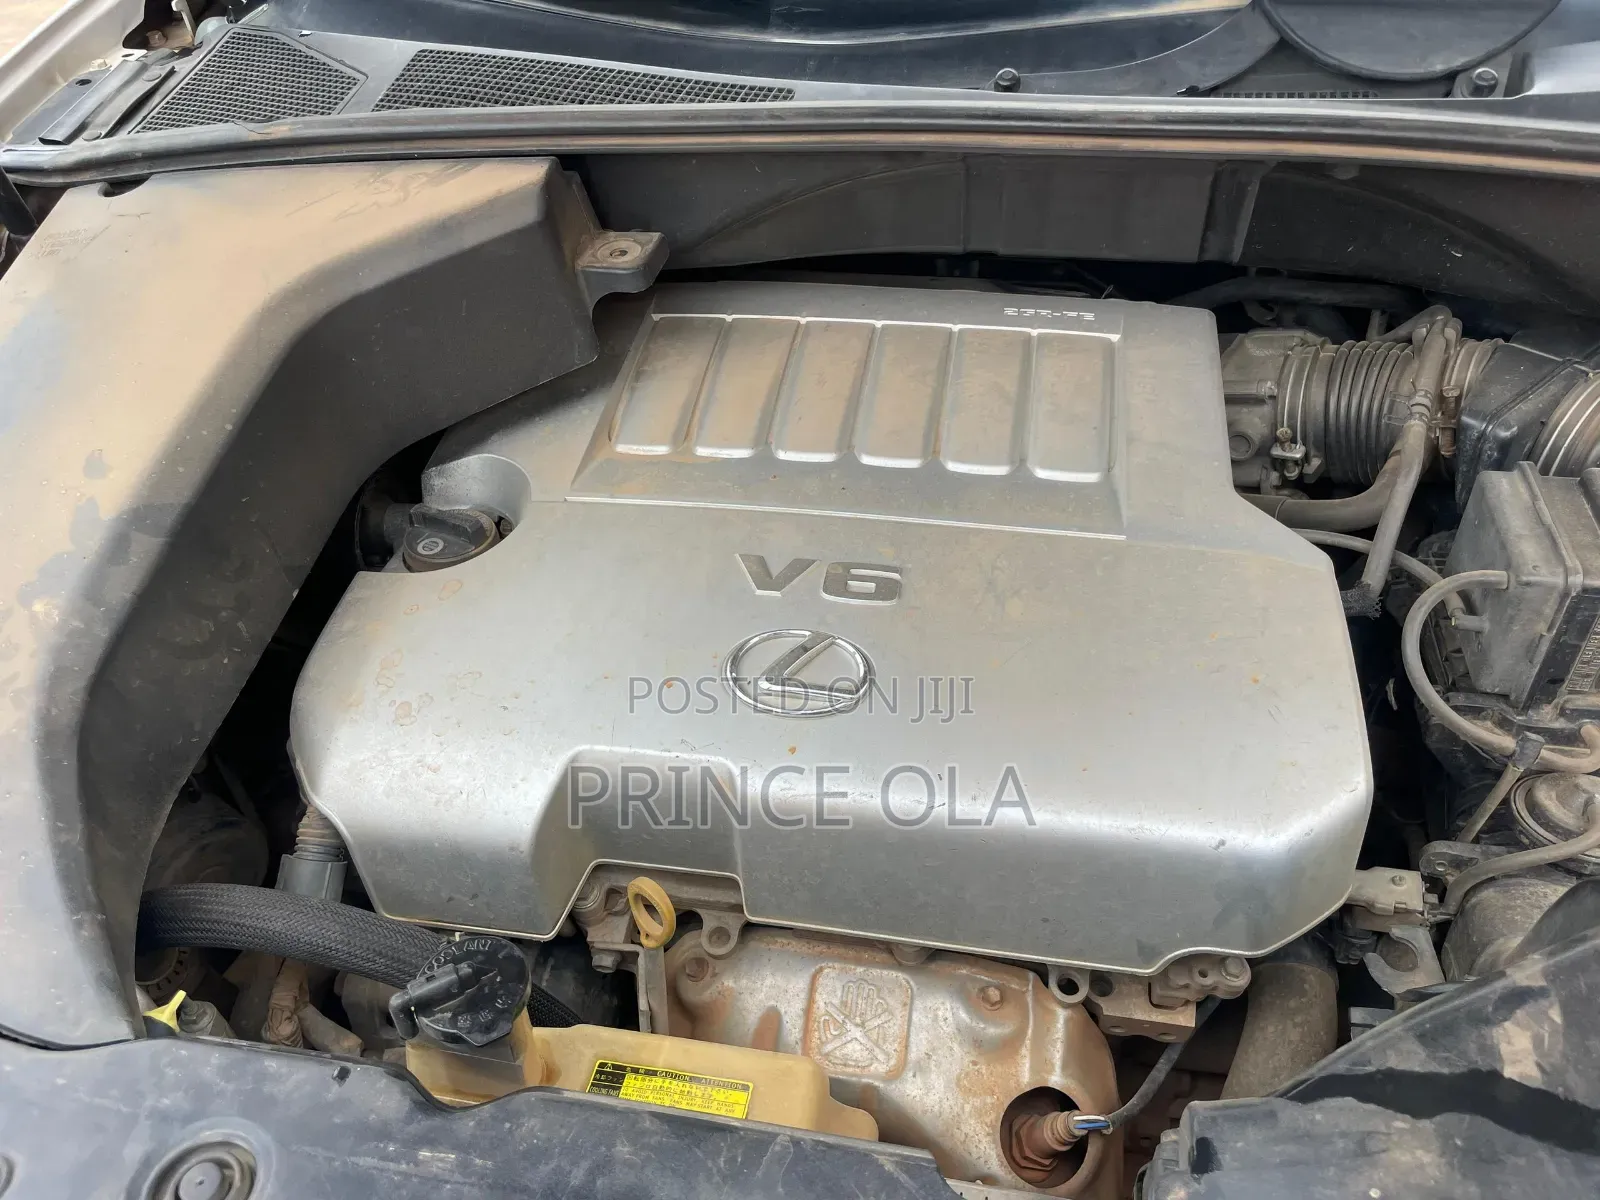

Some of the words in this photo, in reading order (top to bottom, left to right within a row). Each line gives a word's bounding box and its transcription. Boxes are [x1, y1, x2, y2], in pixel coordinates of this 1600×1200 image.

[734, 553, 903, 606] V6
[656, 1070, 690, 1082] CAUTION
[700, 1078, 743, 1089] ATTENTION
